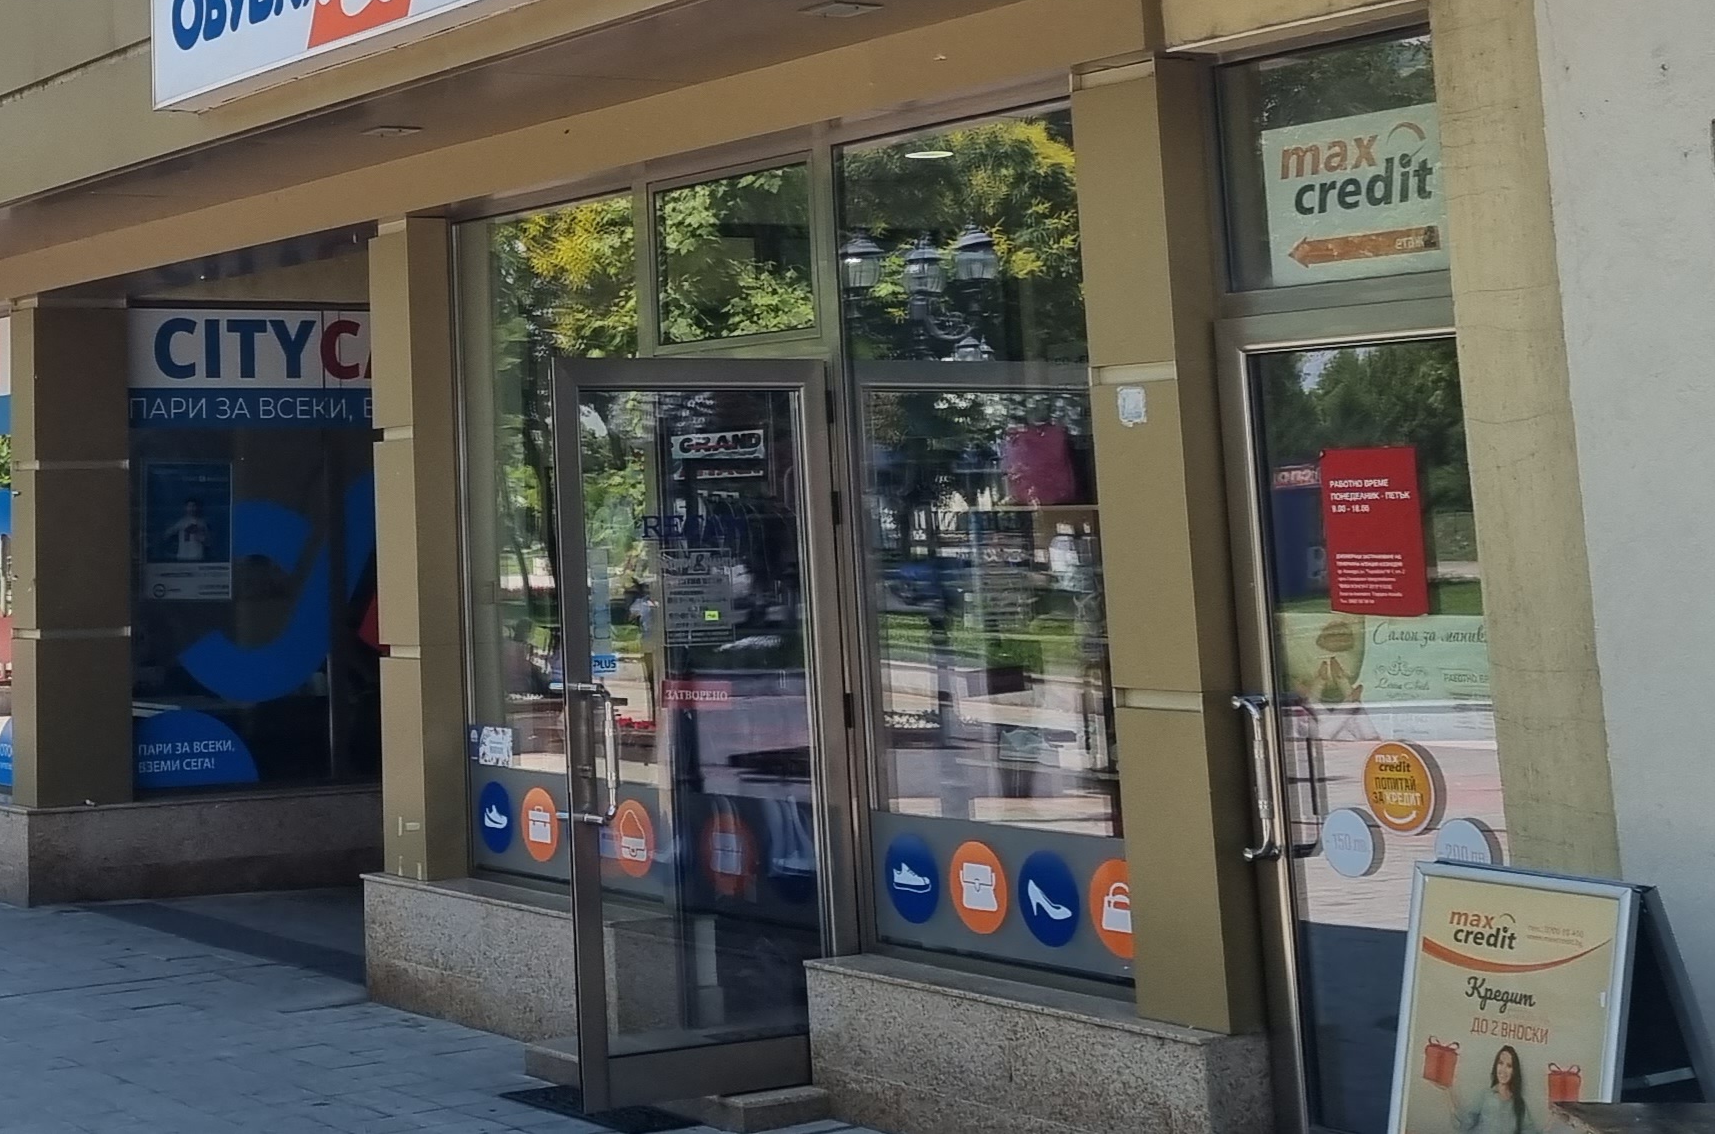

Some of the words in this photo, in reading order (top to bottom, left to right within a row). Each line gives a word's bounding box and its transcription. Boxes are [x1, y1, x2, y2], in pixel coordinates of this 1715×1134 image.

[1280, 134, 1379, 180] max
[1294, 152, 1434, 216] credit
[153, 316, 372, 380] CITYC
[130, 397, 206, 419] ПАРИ
[215, 397, 251, 419] ЗА
[259, 397, 353, 422] ВСЕКИ,
[1329, 479, 1363, 489] РАБОТНО
[1372, 621, 1419, 645] Салон
[665, 689, 728, 702] ЗАТВОРЕНО
[138, 742, 173, 756] ПАРИ
[174, 742, 190, 755] ЗА
[1375, 753, 1400, 764] max
[138, 758, 181, 774] ВЗЕМИ
[182, 756, 216, 771] СЕГА!
[1379, 762, 1412, 773] credit
[1374, 775, 1417, 792] ПОПИТАЙ
[1448, 911, 1494, 930] max
[1453, 926, 1517, 950] credit
[1465, 976, 1536, 1014] Кредит
[1471, 1017, 1489, 1035] ДО
[1490, 1021, 1499, 1036] 2
[1501, 1022, 1549, 1045] ВНОСКИ
